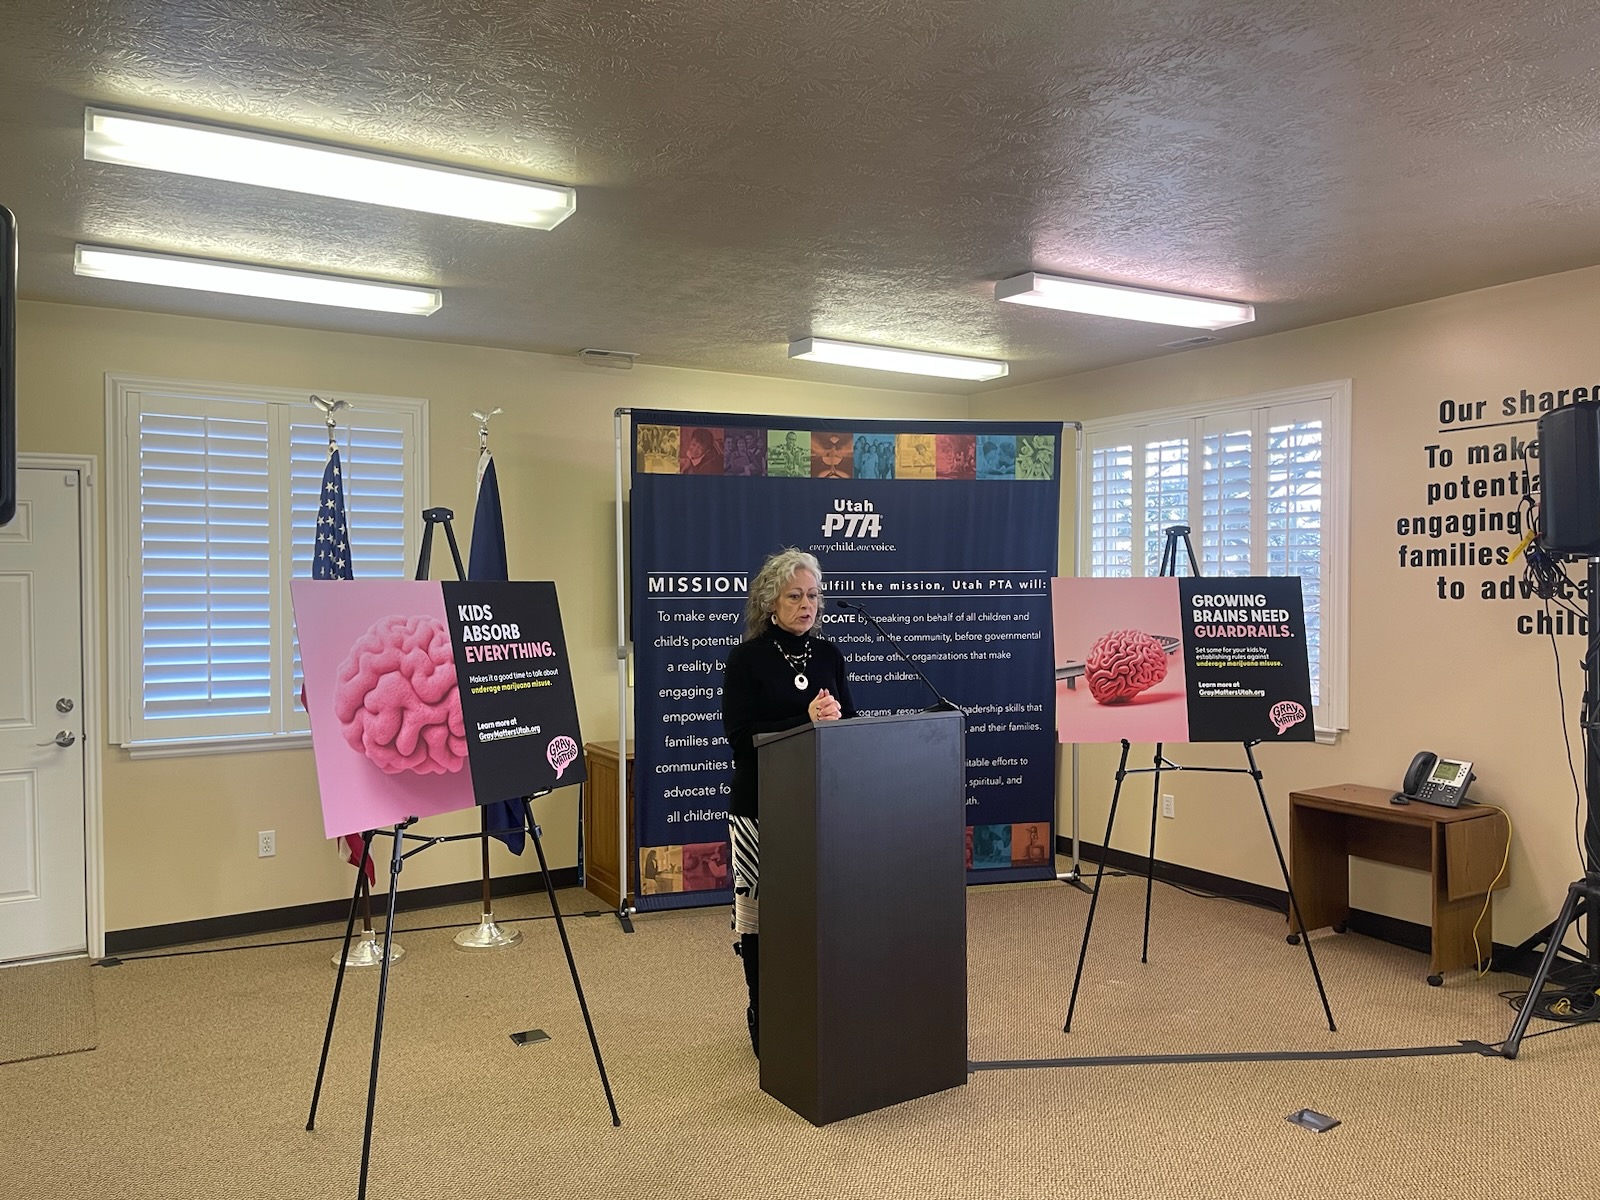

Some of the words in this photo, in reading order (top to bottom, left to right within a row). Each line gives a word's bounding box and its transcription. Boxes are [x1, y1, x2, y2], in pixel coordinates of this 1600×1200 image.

[1440, 400, 1487, 424] Our
[1502, 385, 1600, 416] share
[1424, 444, 1453, 468] To
[1427, 471, 1541, 505] potentia
[834, 499, 874, 512] Utah
[821, 513, 882, 538] PTA
[1397, 508, 1522, 538] engaging
[1399, 542, 1510, 567] families
[648, 577, 748, 592] MISSION
[821, 580, 854, 590] ulfill
[861, 580, 884, 590] the
[890, 580, 946, 590] mission,
[952, 580, 983, 590] Utah
[989, 579, 1013, 590] PTA
[1019, 578, 1047, 588] will:
[1436, 576, 1465, 600] to
[1192, 594, 1267, 608] GROWING
[458, 604, 494, 622] KIDS
[657, 611, 670, 622] To
[674, 610, 706, 622] make
[708, 613, 740, 624] every
[821, 614, 856, 624] OCATE
[871, 614, 911, 625] speaking
[926, 612, 953, 622] behalf
[955, 612, 966, 622] of
[966, 612, 976, 622] all
[978, 612, 1012, 622] children
[1013, 612, 1030, 621] and
[1192, 610, 1249, 623] BRAINS
[1251, 610, 1290, 622] NEED
[462, 624, 521, 642] ABSORB
[838, 634, 874, 644] schools,
[876, 634, 885, 642] in
[903, 633, 952, 644] community,
[954, 631, 983, 641] before
[984, 630, 1041, 643] governmental
[1194, 624, 1295, 638] GUARDRAILS.
[653, 636, 690, 647] child's
[691, 634, 743, 649] potential
[465, 642, 556, 663] EVERYTHING.
[855, 653, 884, 662] before
[912, 651, 968, 664] organizations
[970, 650, 987, 660] that
[988, 650, 1012, 660] make
[1195, 653, 1232, 661] establishing
[666, 664, 674, 672] a
[677, 660, 713, 674] reality
[1196, 660, 1226, 668] underage
[1226, 660, 1260, 668] marijuana
[469, 674, 489, 684] Makes
[498, 672, 513, 682] good
[513, 672, 526, 680] time
[532, 670, 543, 678] talk
[543, 668, 558, 676] about
[846, 672, 882, 684] ffecting
[471, 685, 501, 694] underage
[501, 681, 531, 692] marijuana
[531, 680, 552, 688] misuse.
[658, 685, 714, 700] engaging
[1198, 689, 1266, 697] GrayMattersUtah.org
[1004, 702, 1026, 713] skills
[1026, 702, 1042, 712] that
[1272, 703, 1298, 716] GRAY
[662, 710, 723, 726] empoweri
[1274, 708, 1305, 726] MATTERS
[477, 721, 495, 731] Learn
[495, 720, 511, 728] more
[510, 718, 518, 726] at
[969, 724, 986, 732] and
[988, 724, 1007, 732] their
[1008, 723, 1042, 732] families.
[478, 725, 541, 741] GrayMattersUtah.org
[550, 739, 571, 756] GRAY
[664, 735, 709, 748] families
[551, 744, 576, 768] MATTERS
[966, 758, 990, 767] itable
[991, 757, 1018, 766] efforts
[1019, 758, 1028, 766] to
[655, 760, 728, 774] communities
[968, 777, 1004, 788] spiritual,
[1006, 775, 1022, 785] and
[663, 786, 716, 798] advocate
[666, 810, 681, 823] all
[683, 808, 729, 822] children
